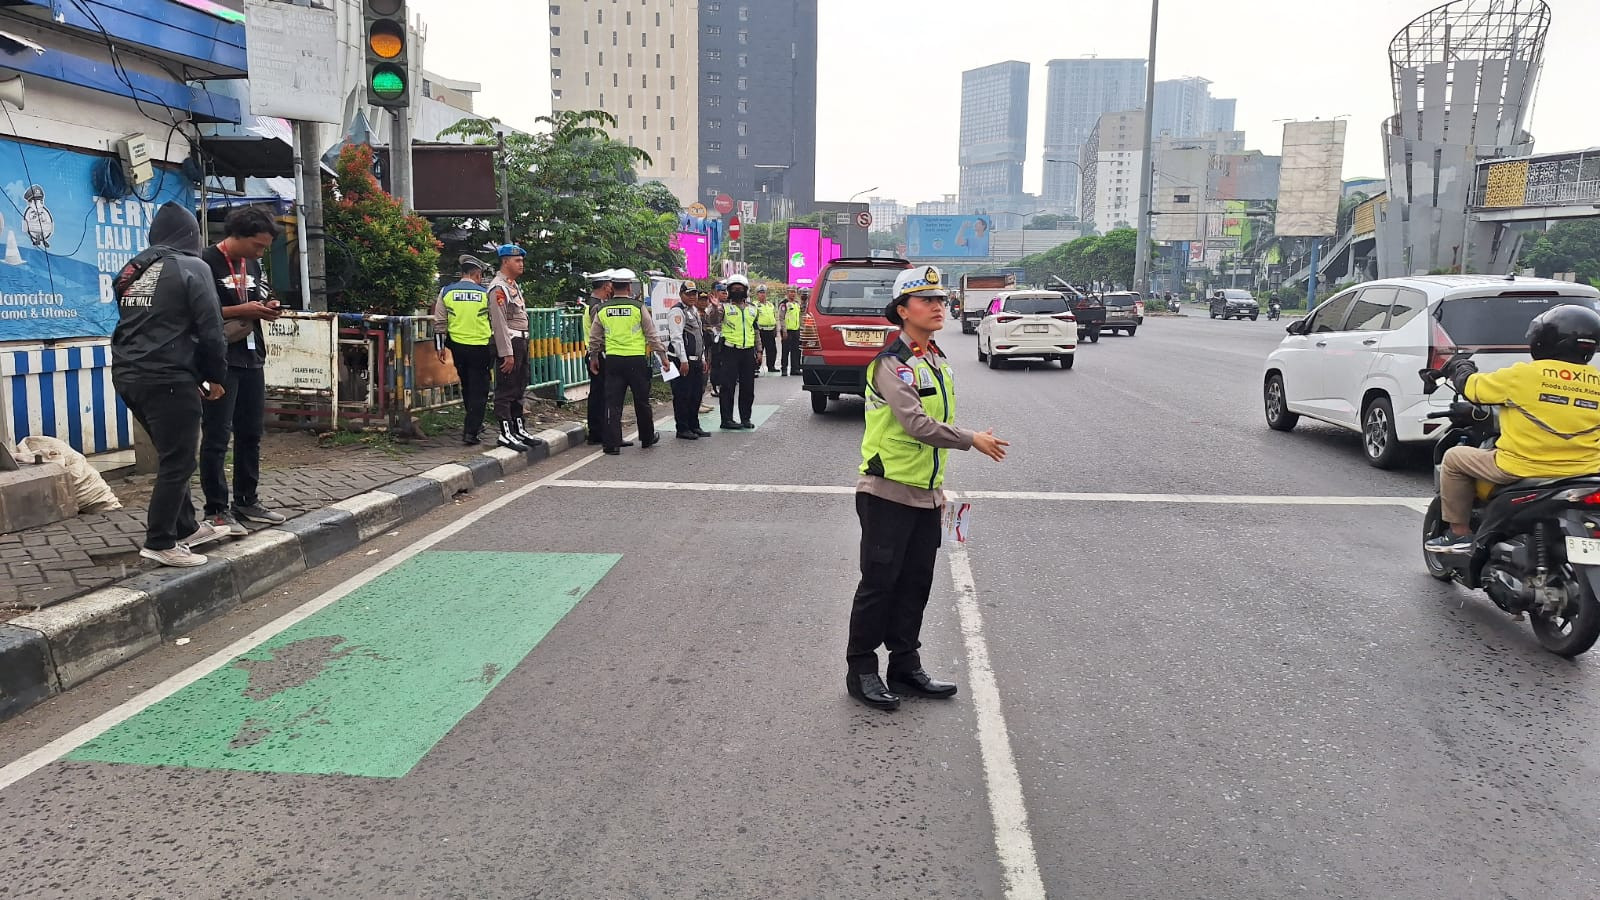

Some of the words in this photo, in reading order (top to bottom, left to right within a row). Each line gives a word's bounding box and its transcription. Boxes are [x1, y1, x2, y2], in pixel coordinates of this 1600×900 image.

[96, 225, 131, 251] LALU
[453, 292, 481, 301] POLISI
[607, 308, 631, 316] POLISI
[1543, 369, 1600, 386] maxim
